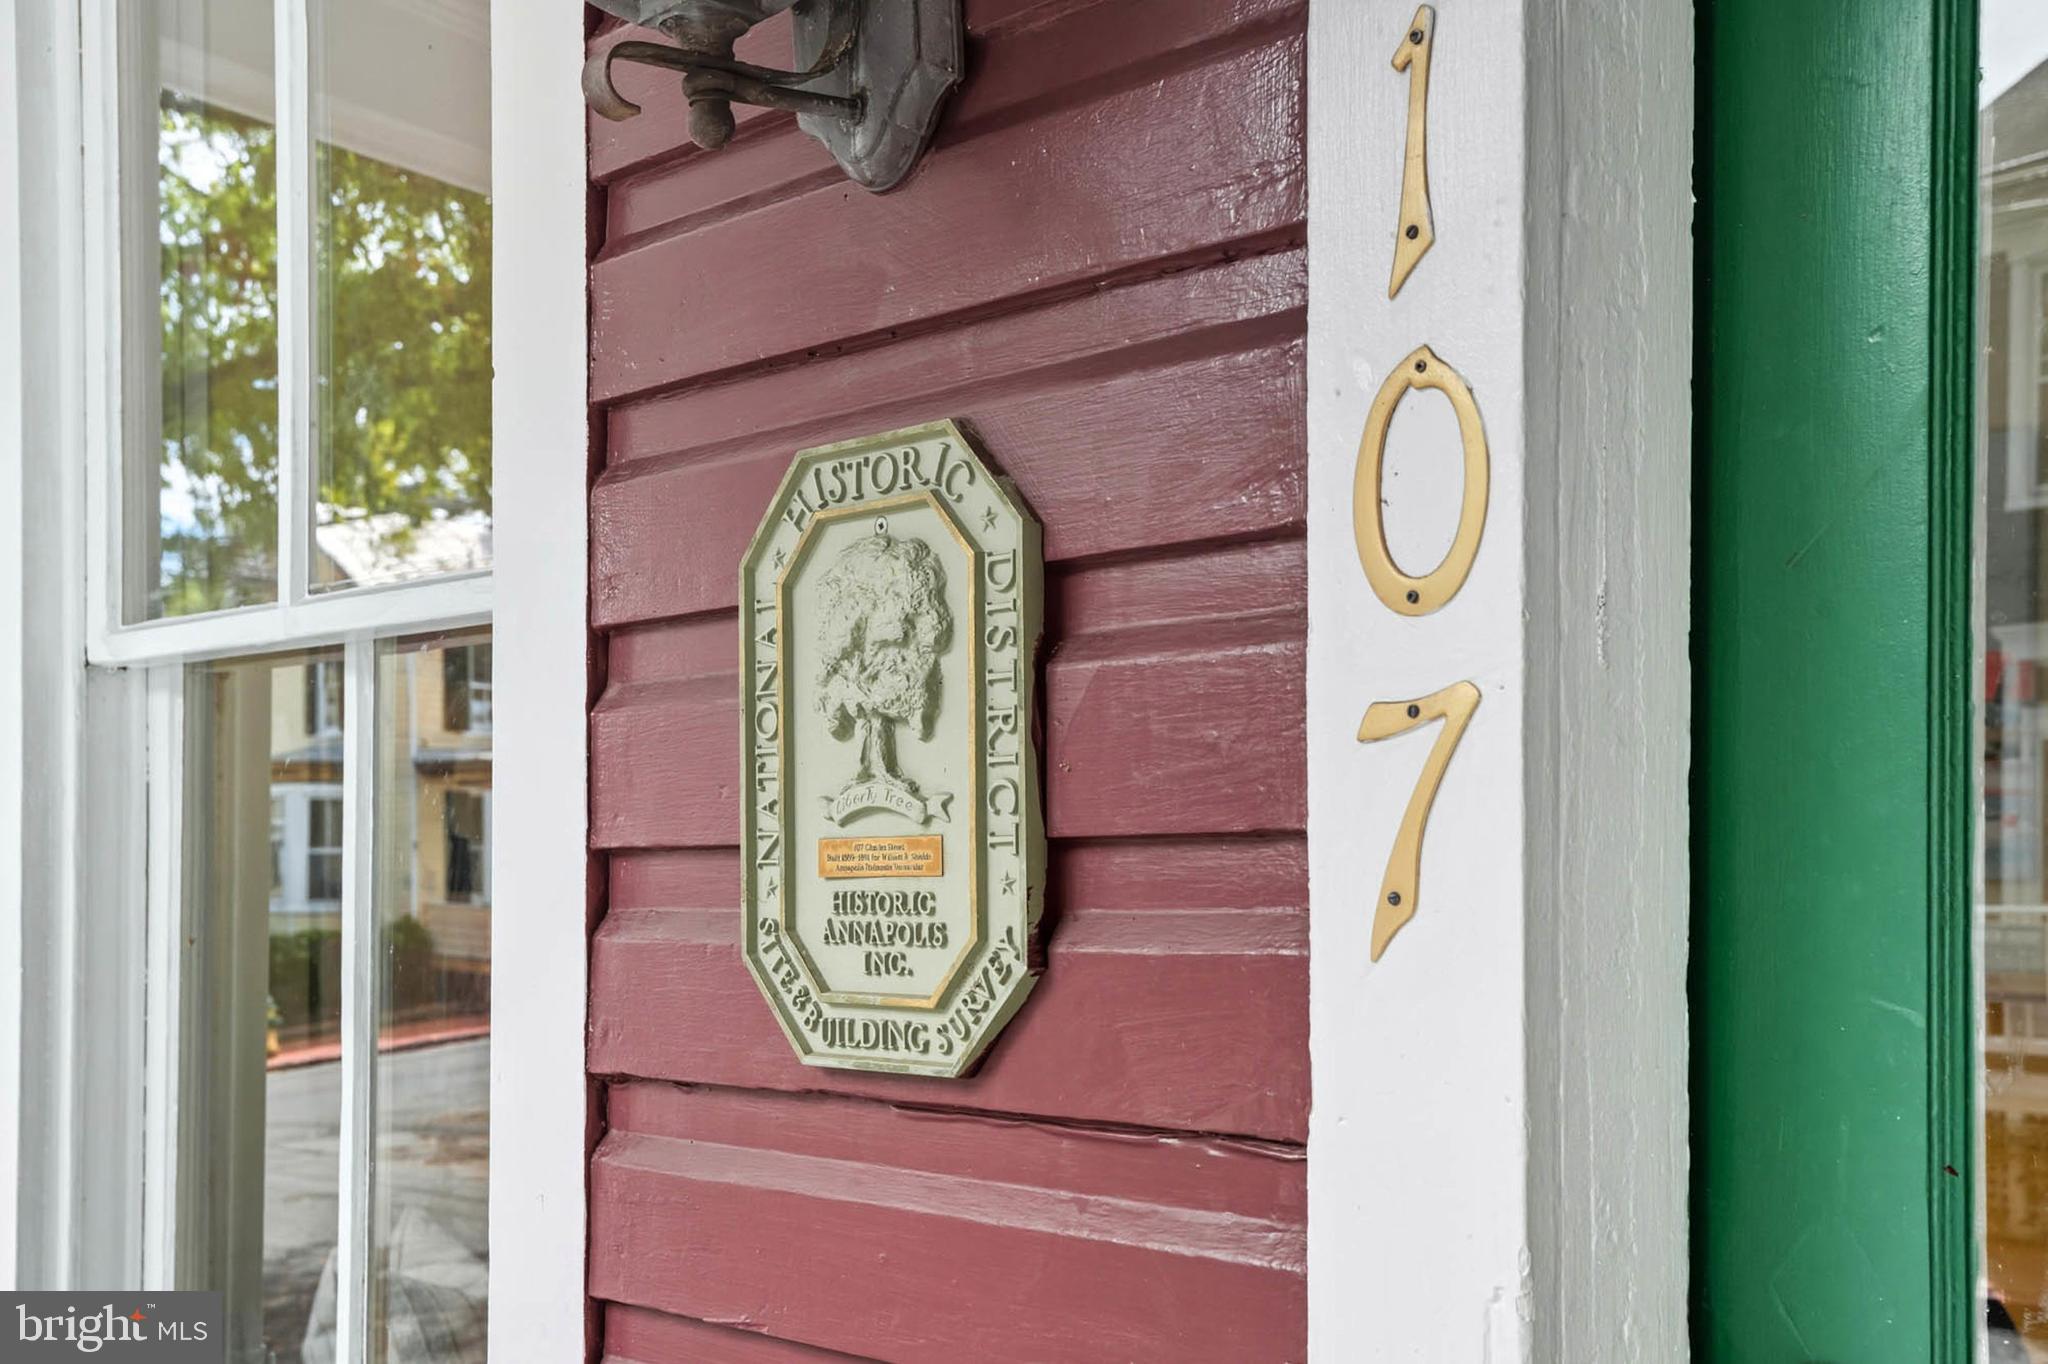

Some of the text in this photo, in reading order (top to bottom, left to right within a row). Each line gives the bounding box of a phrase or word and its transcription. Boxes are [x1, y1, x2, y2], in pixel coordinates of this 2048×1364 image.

[782, 441, 976, 534] HISTORIC
[1353, 5, 1490, 963] 107
[755, 583, 780, 871] NATIONAL
[984, 548, 1020, 857] DISTRICT
[884, 787, 914, 811] Tree
[824, 918, 949, 949] ANNAPOLIS
[832, 890, 937, 916] HISTORIC
[759, 917, 801, 995] SITE
[803, 1001, 931, 1054] BUILDING
[937, 925, 1022, 1055] SURVEY
[863, 951, 914, 977] INC.
